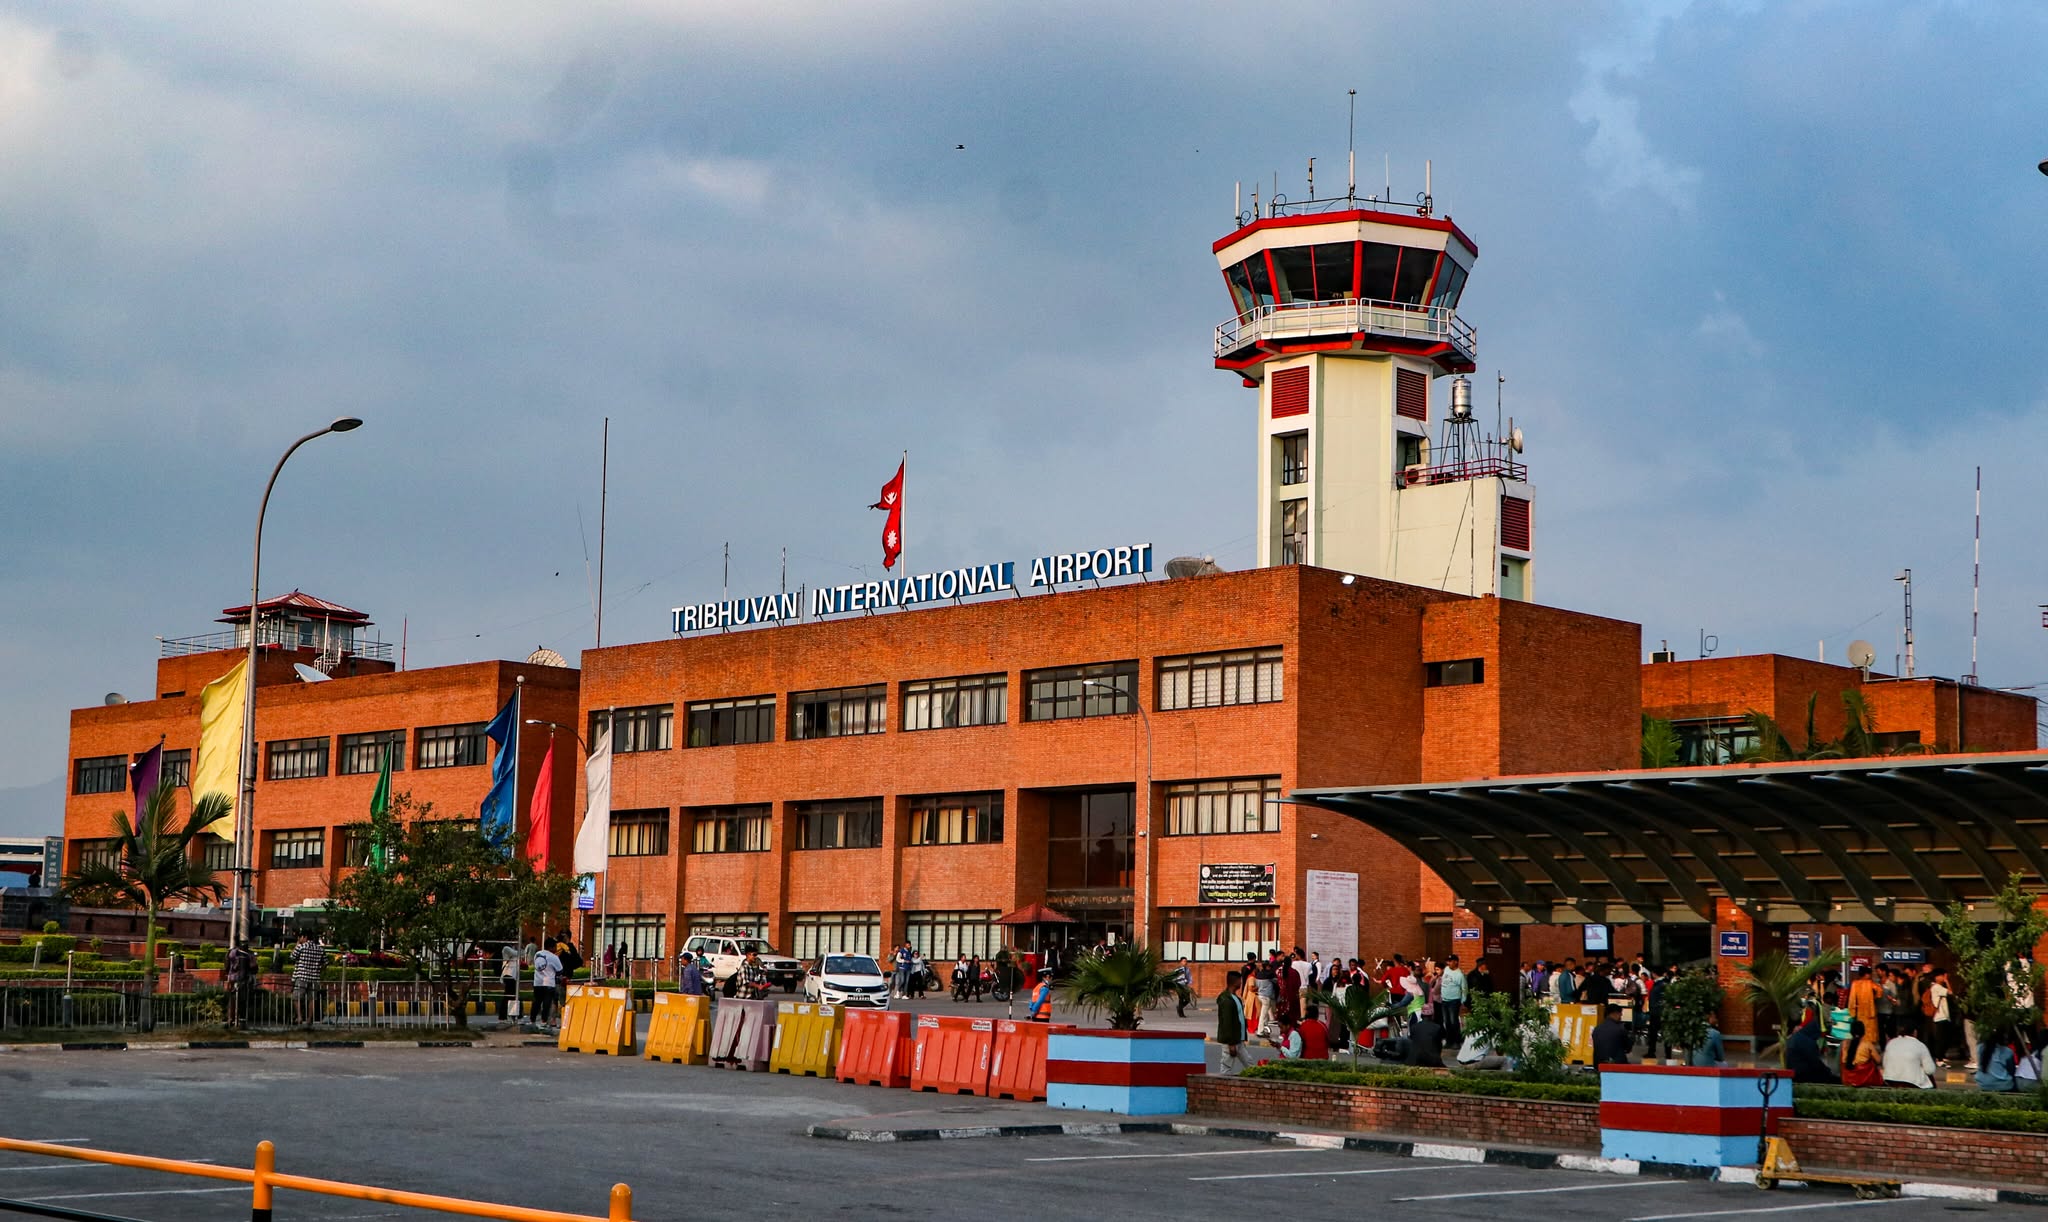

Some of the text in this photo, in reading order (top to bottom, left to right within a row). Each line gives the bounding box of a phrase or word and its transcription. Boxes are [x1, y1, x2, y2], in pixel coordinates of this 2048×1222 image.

[671, 543, 1150, 632] TRIBHUVAN INTERNATIONAL AIRPORT
